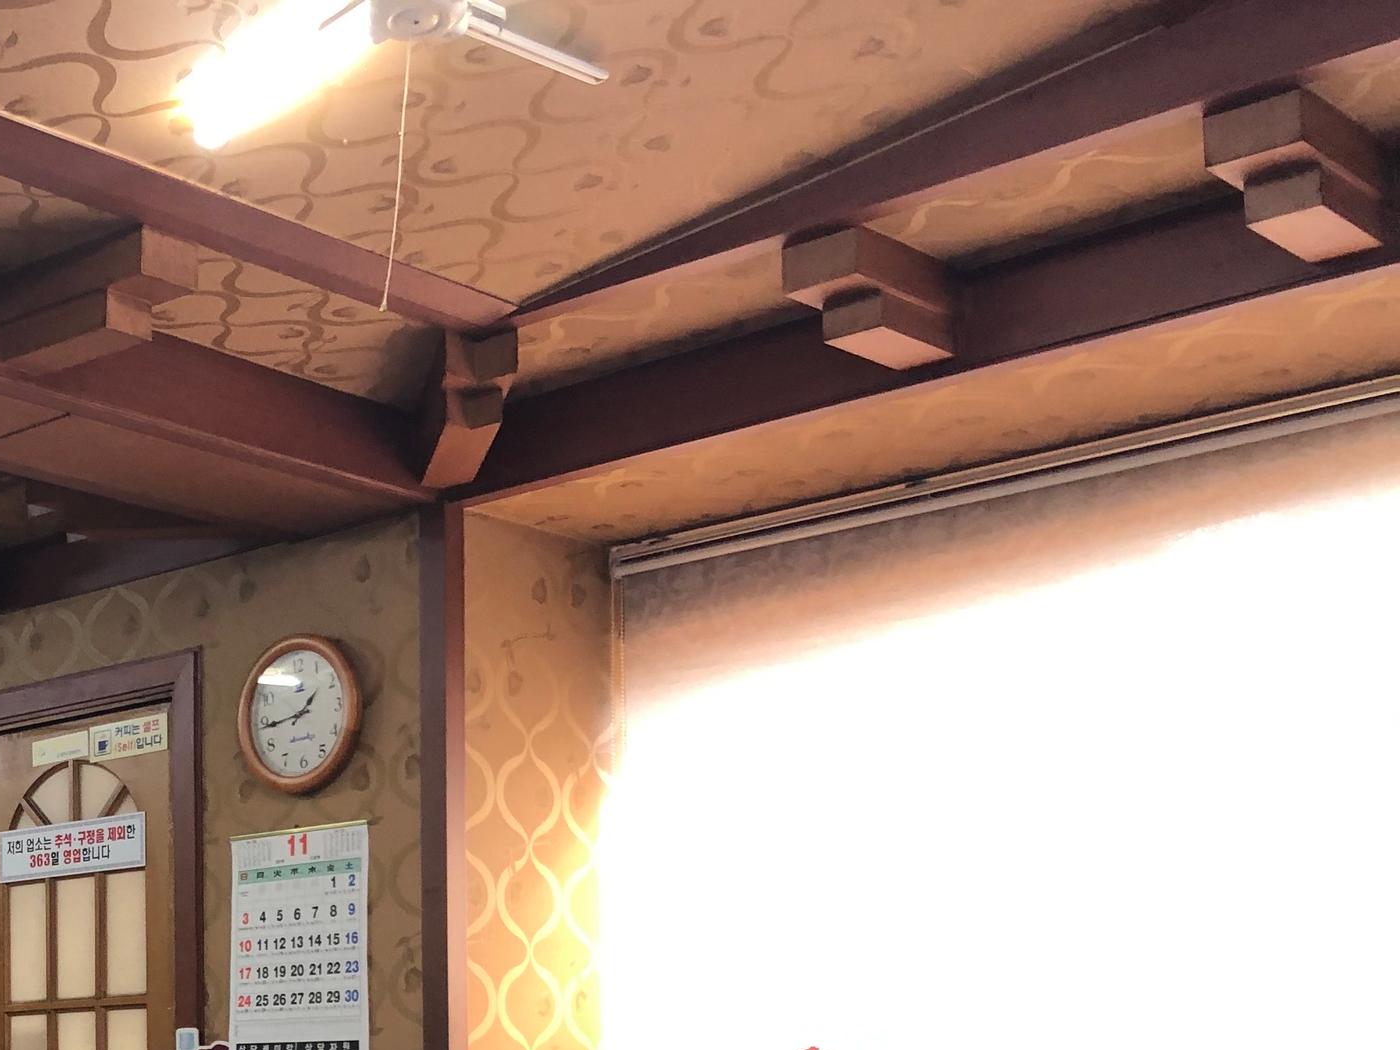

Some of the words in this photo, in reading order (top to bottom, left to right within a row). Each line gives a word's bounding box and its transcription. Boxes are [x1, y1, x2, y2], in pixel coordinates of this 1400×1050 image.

[293, 658, 304, 673] 12
[262, 691, 275, 707] 10
[334, 697, 342, 712] 3
[114, 722, 141, 738] 커피는
[142, 718, 160, 733] 셀프
[267, 738, 276, 752] 8
[318, 744, 326, 758] 5
[281, 753, 289, 767] 7
[300, 755, 308, 768] 6
[6, 839, 24, 855] 저희
[26, 836, 52, 853] 업소는
[107, 824, 136, 842] 제외한
[287, 833, 308, 857] 11
[29, 851, 60, 868] 363일
[63, 845, 111, 864] 영업합니다
[331, 876, 336, 888] 1
[348, 874, 356, 887] 2
[242, 912, 249, 925] 3
[259, 911, 266, 923] 4
[276, 909, 283, 922] 5
[293, 908, 301, 920] 6
[312, 906, 319, 918] 7
[330, 905, 337, 917] 8
[348, 902, 356, 915] 9
[239, 940, 252, 952] 10
[257, 939, 268, 951] 11
[273, 937, 286, 950] 12
[291, 936, 304, 948] 13
[308, 934, 322, 947] 14
[327, 933, 340, 945] 15
[345, 931, 359, 944] 16
[239, 967, 252, 979] 17
[256, 966, 269, 979] 18
[273, 965, 286, 978] 19
[290, 964, 304, 976] 20
[309, 963, 322, 976] 21
[327, 962, 341, 974] 22
[345, 960, 359, 973] 23
[238, 995, 251, 1008] 24
[255, 994, 269, 1007] 25
[272, 993, 286, 1006] 26
[290, 992, 304, 1005] 27
[308, 992, 322, 1004] 28
[326, 991, 340, 1003] 29
[344, 990, 359, 1003] 30
